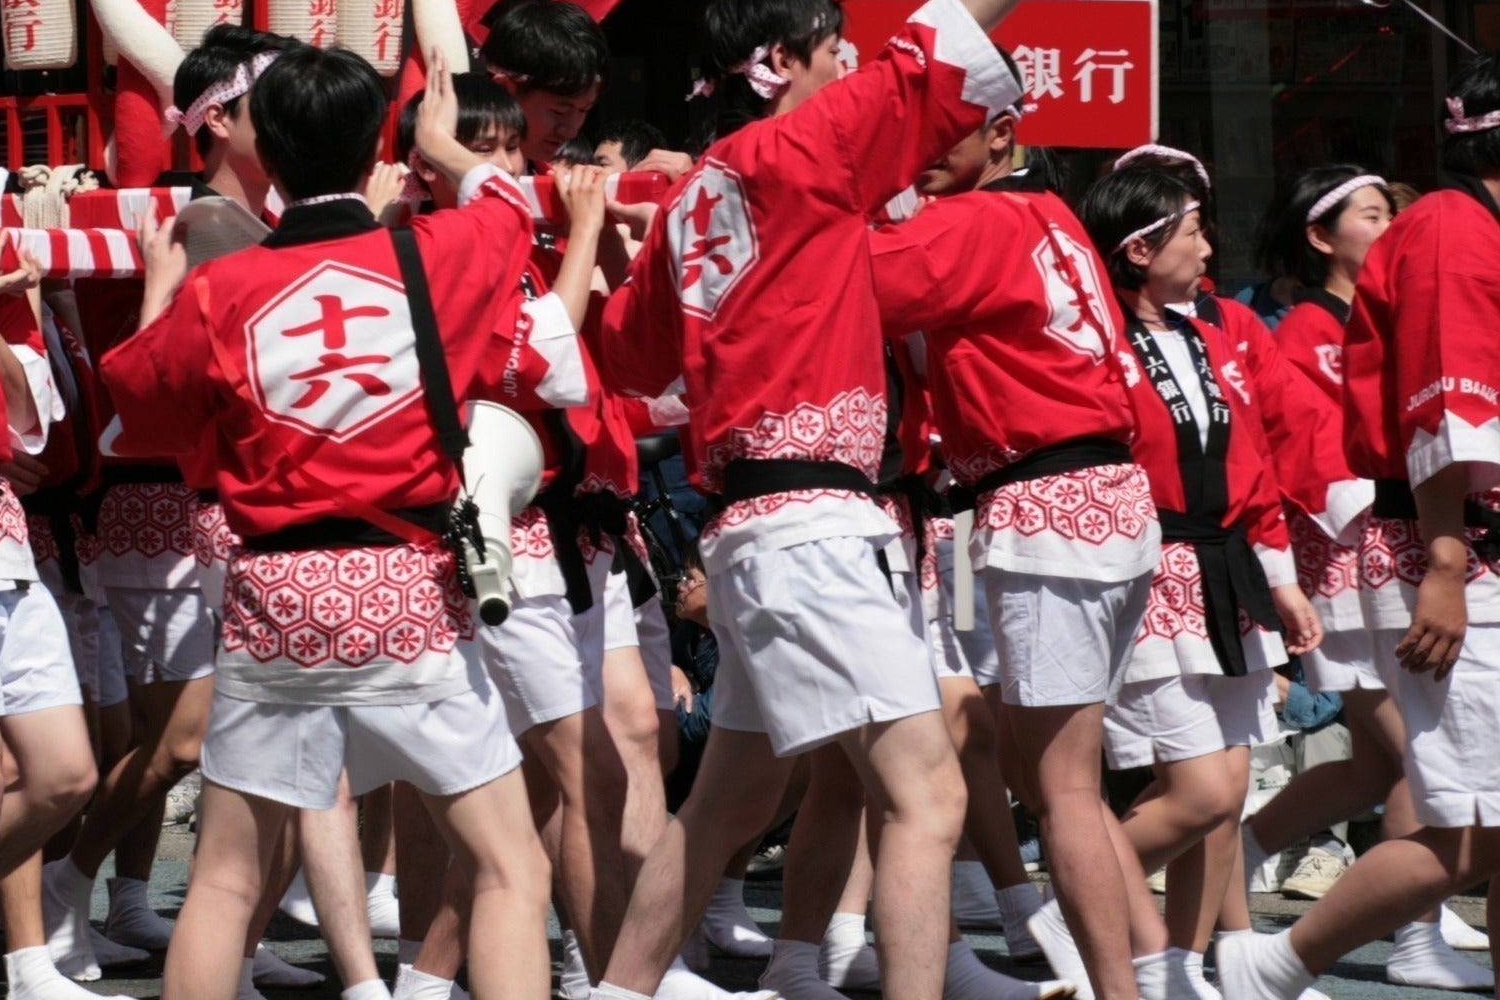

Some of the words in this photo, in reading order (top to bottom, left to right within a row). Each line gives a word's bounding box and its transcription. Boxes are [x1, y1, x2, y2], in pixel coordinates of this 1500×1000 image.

[281, 294, 391, 409] 十六
[1132, 331, 1192, 425] 十六銀行
[1192, 336, 1231, 425] 十六銀行
